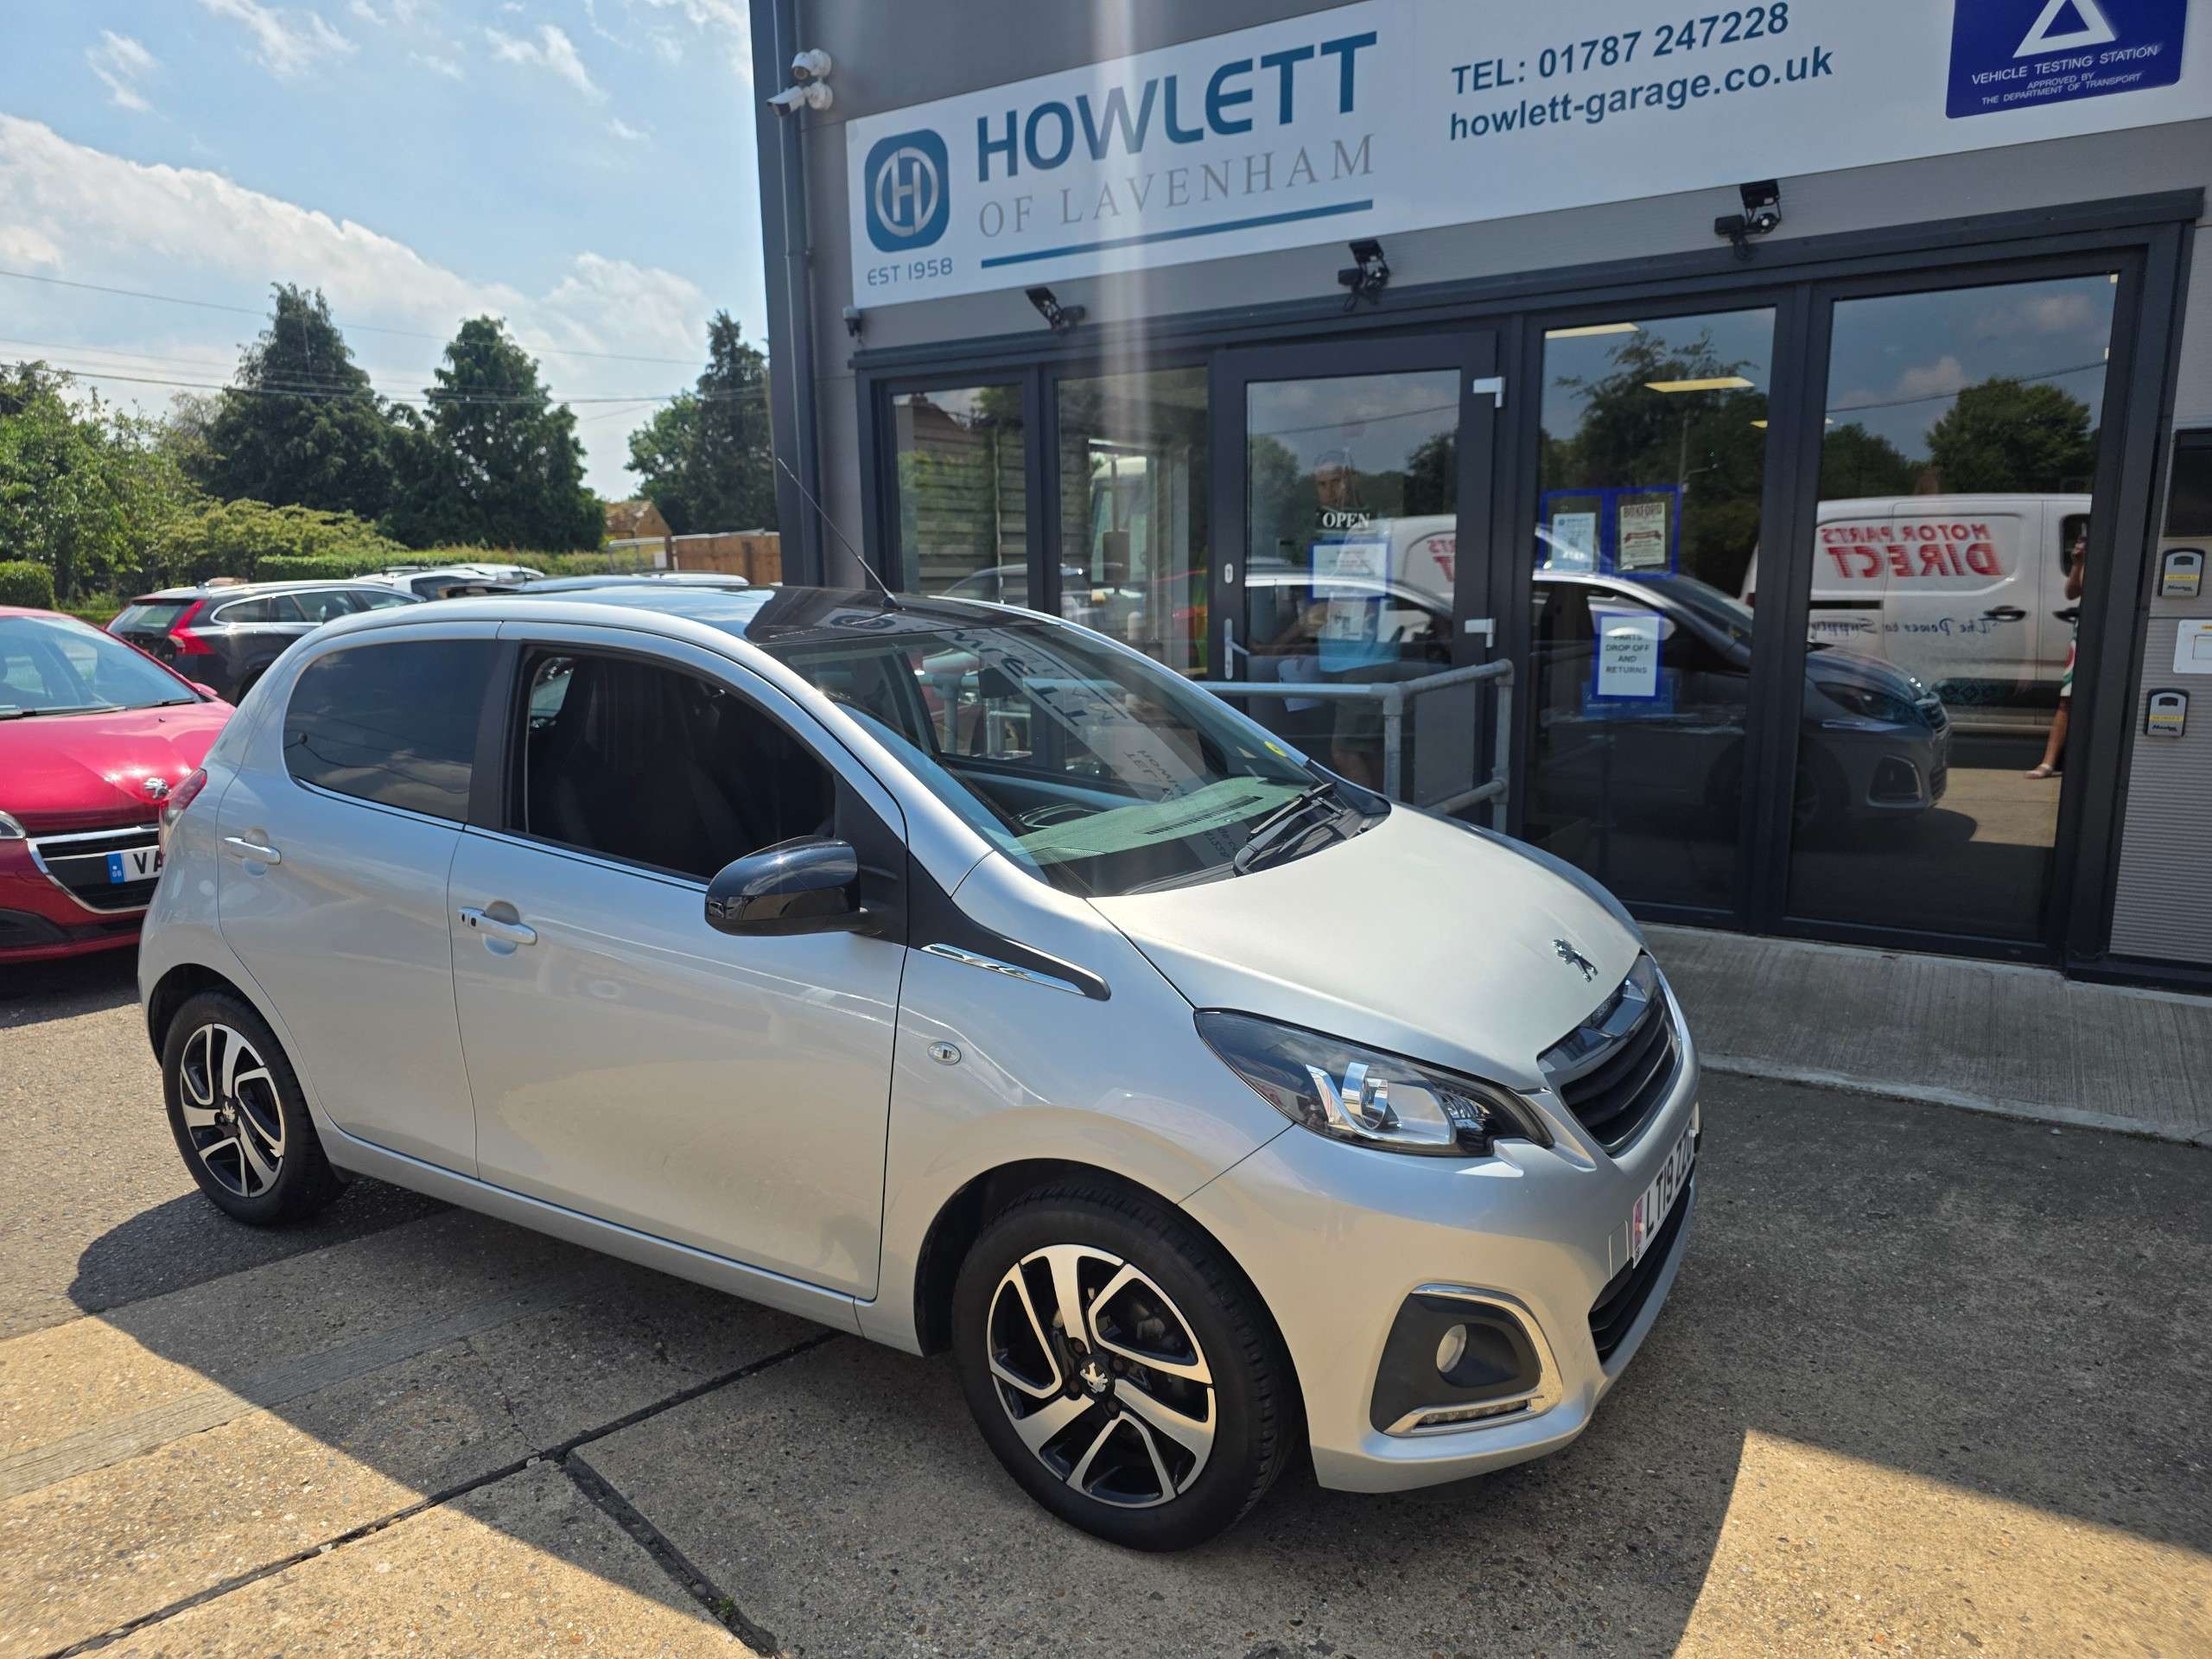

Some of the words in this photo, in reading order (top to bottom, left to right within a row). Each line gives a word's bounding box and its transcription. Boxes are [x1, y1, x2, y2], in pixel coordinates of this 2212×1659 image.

[1451, 59, 1526, 94] TEL:
[1538, 30, 1642, 78] 01787
[1653, 2, 1789, 57] 247228
[1972, 66, 2028, 85] VEHICLE
[2034, 55, 2094, 75] TESTING
[2100, 45, 2158, 65] STATION
[976, 30, 1377, 182] HOWLETT
[1450, 46, 1834, 141] howlett-garage.co.uk
[1981, 95, 1999, 105] THE
[2003, 86, 2063, 103] DEPARTMENT
[2068, 82, 2080, 92] OF
[2085, 73, 2142, 90] TRANSPORT
[2027, 74, 2077, 89] APPROVED
[2082, 73, 2094, 81] BY
[979, 194, 1033, 238] OF
[1059, 133, 1376, 226] LAVENHAM
[868, 264, 900, 286] EST
[908, 257, 953, 281] 1958
[1322, 512, 1370, 528] OPEN
[1645, 1154, 1674, 1240] LT19
